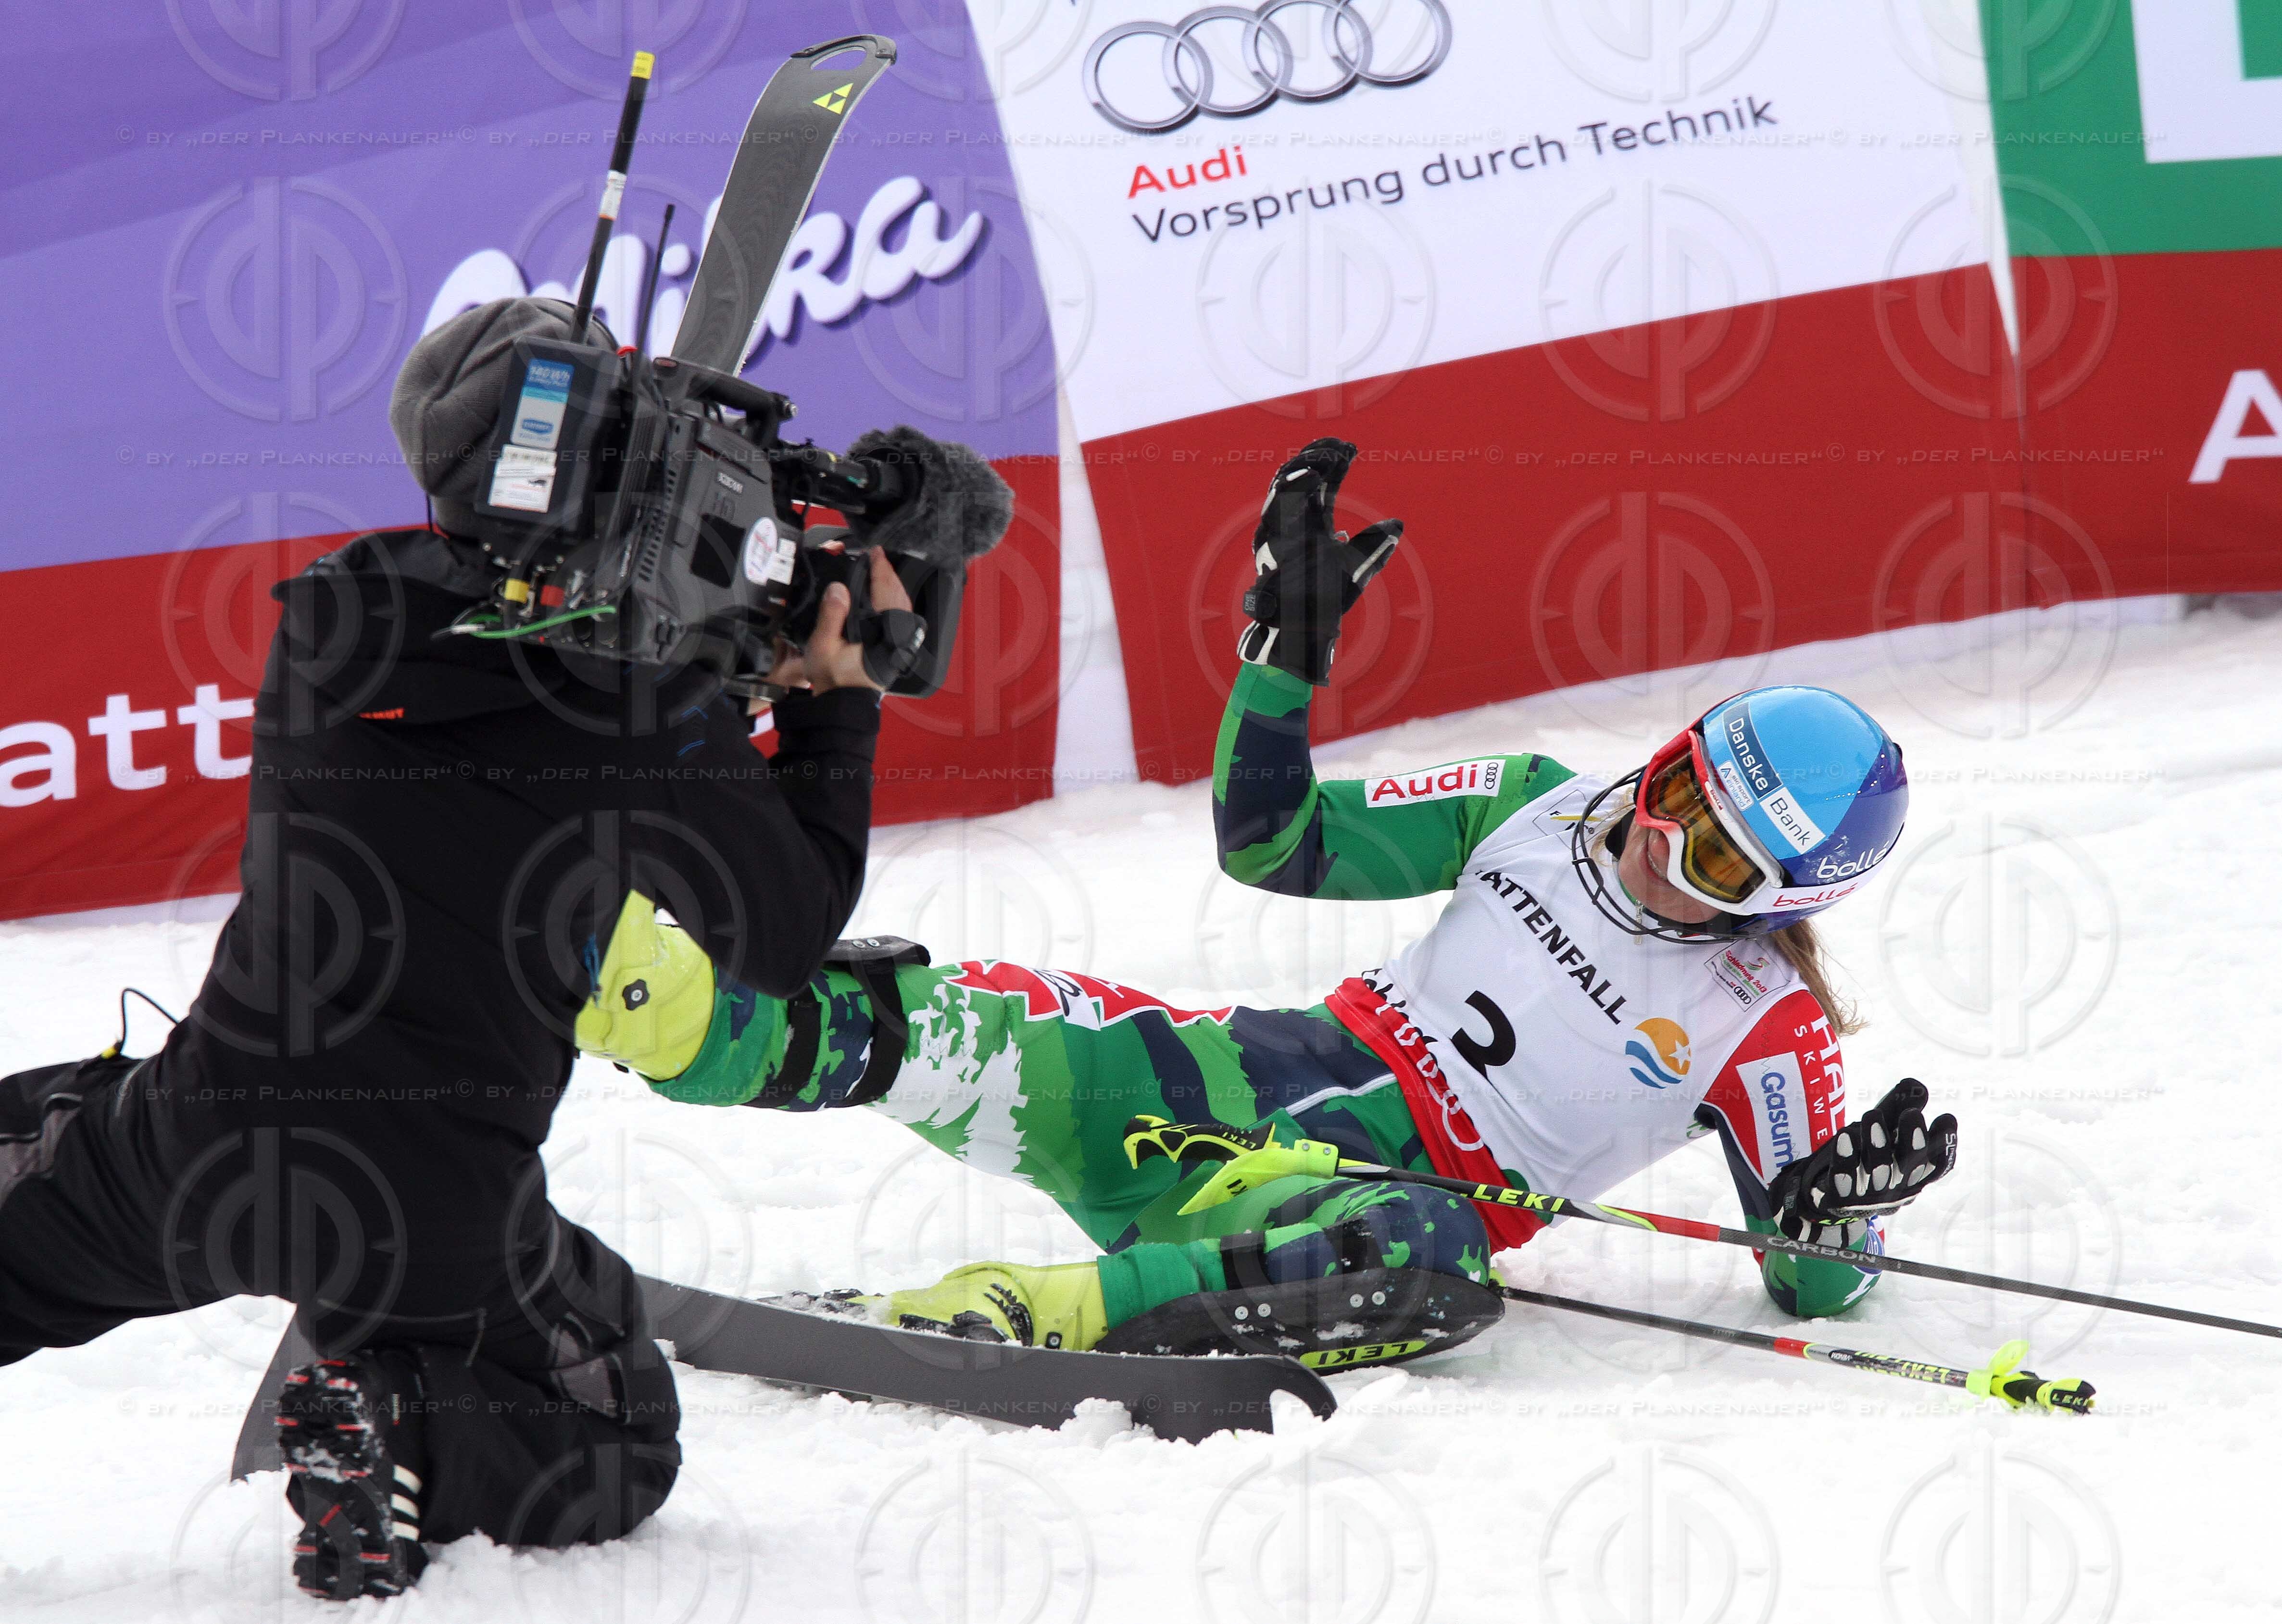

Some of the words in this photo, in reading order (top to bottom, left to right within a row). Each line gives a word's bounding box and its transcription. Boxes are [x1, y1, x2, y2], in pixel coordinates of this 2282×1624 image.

[1128, 145, 1248, 199] Audi
[1133, 165, 1404, 242] Vorsprung
[1422, 134, 1567, 188] durch
[1578, 95, 1779, 156] Technik
[1371, 763, 1479, 802] Audi
[1729, 717, 1769, 791] Danske
[1770, 797, 1810, 846] Bank
[1816, 840, 1889, 879] bollé
[1773, 882, 1858, 907] bollé
[1476, 870, 1626, 1025] ATTENFALL
[1760, 1071, 1794, 1168] Gasum
[1222, 1131, 1257, 1149] LEKI
[1945, 1133, 1956, 1156] SL
[1472, 1184, 1567, 1213] LEKI
[1768, 1237, 1876, 1264] CARBON
[1318, 1343, 1409, 1365] LEKI
[2052, 1393, 2089, 1408] LEKI
